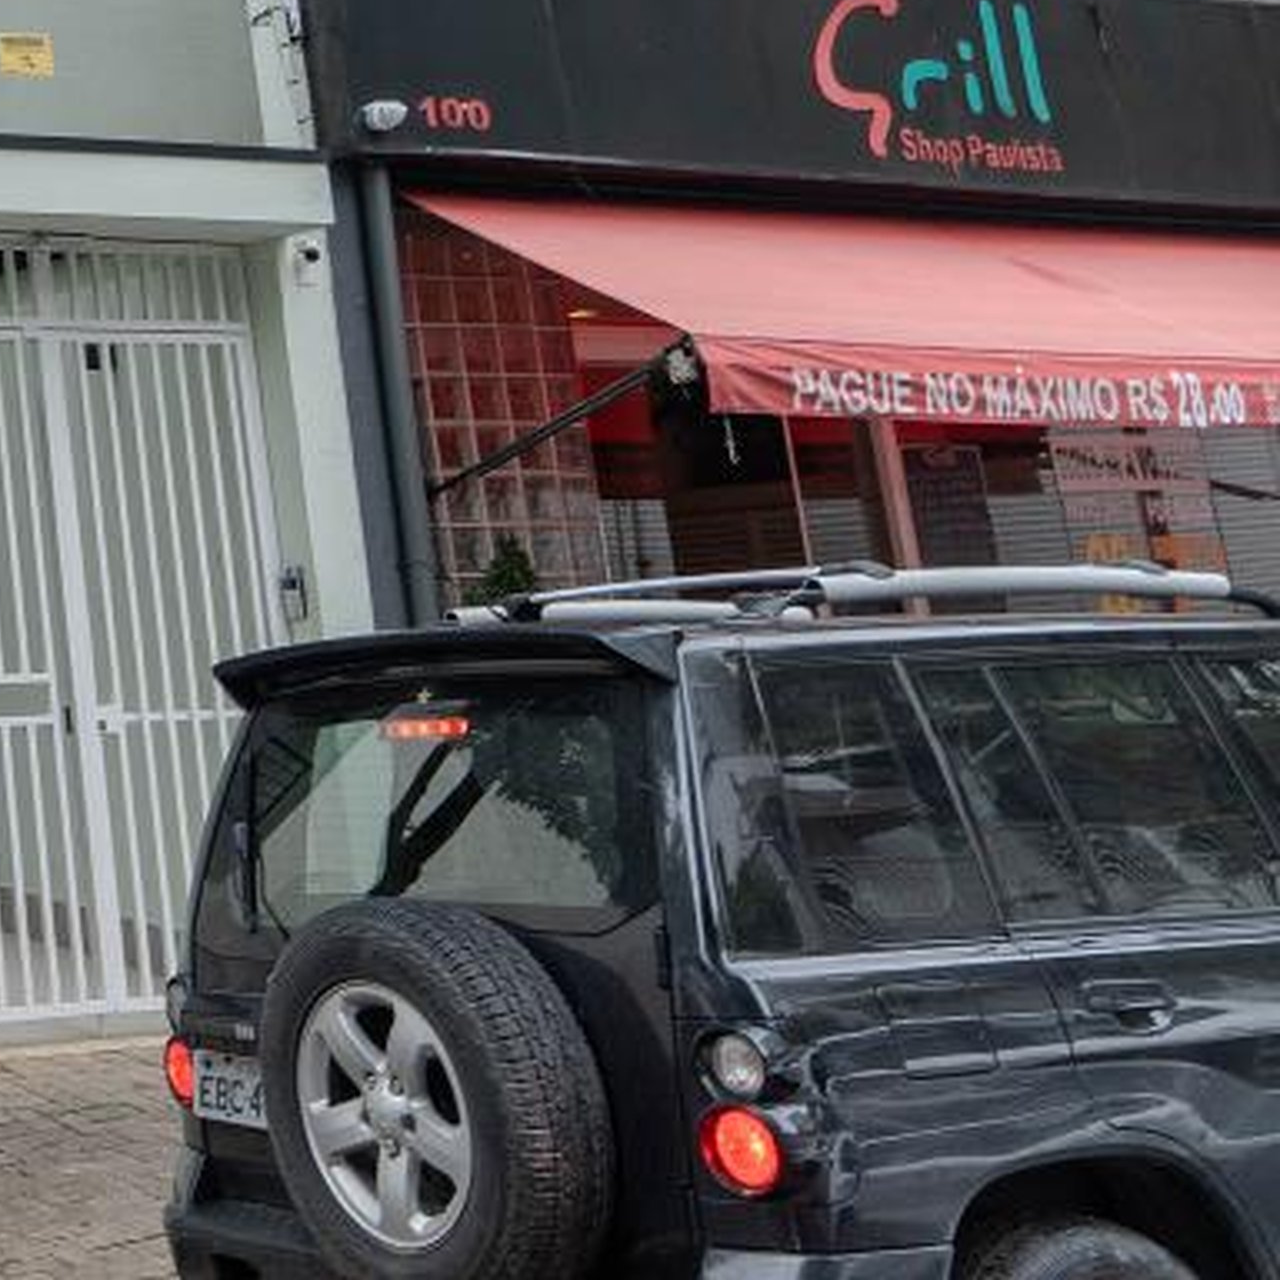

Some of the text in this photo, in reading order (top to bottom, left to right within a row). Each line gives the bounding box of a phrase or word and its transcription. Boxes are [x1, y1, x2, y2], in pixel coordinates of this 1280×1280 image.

[418, 96, 491, 131] 100
[899, 127, 1064, 182] Shop Paulista
[791, 369, 917, 415] PAGUE
[924, 371, 976, 415] NO
[983, 365, 1120, 421] MÁXIMO
